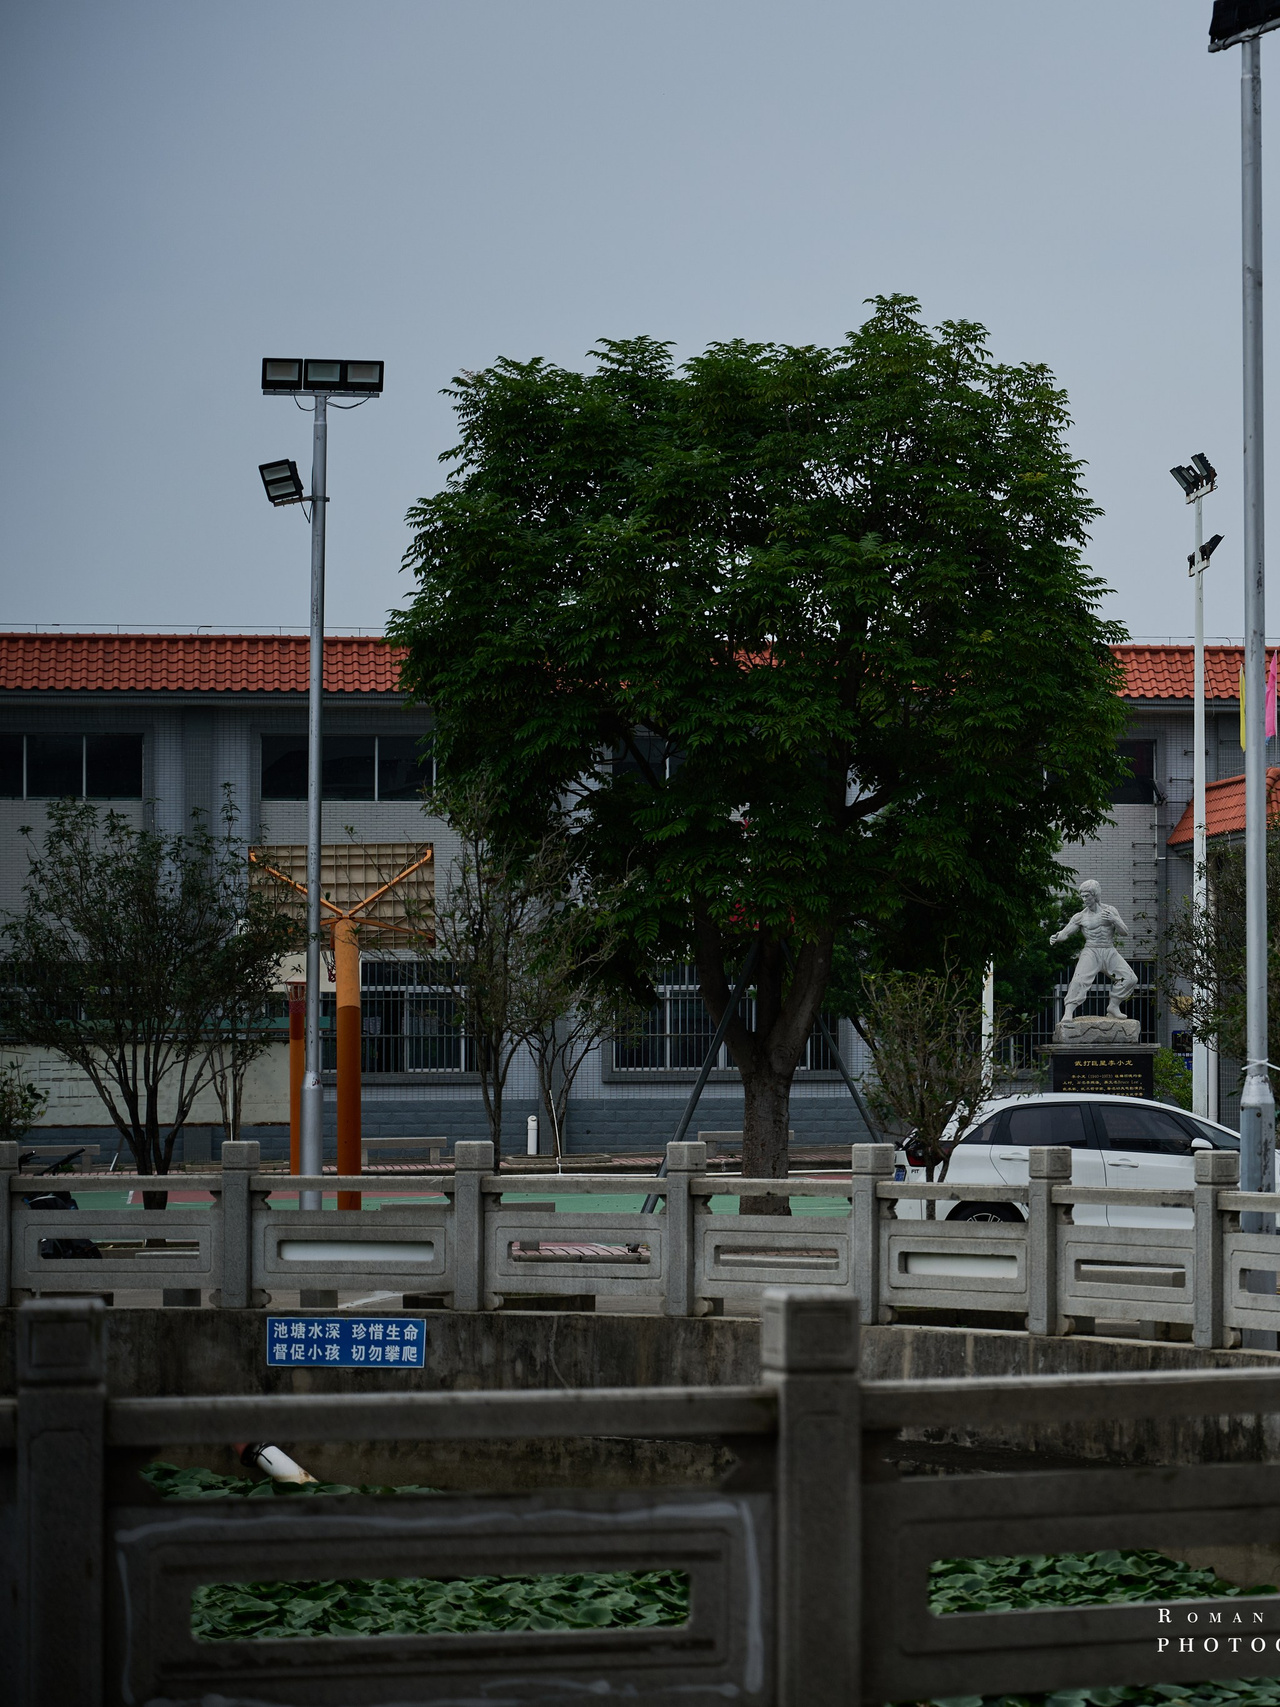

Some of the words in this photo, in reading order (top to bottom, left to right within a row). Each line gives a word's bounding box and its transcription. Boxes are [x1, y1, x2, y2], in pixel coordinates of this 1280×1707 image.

[274, 1322, 340, 1339] 池塘水深
[352, 1323, 419, 1341] 珍惜生命
[273, 1344, 340, 1361] 督促小孩
[351, 1345, 418, 1362] 切勿攀爬
